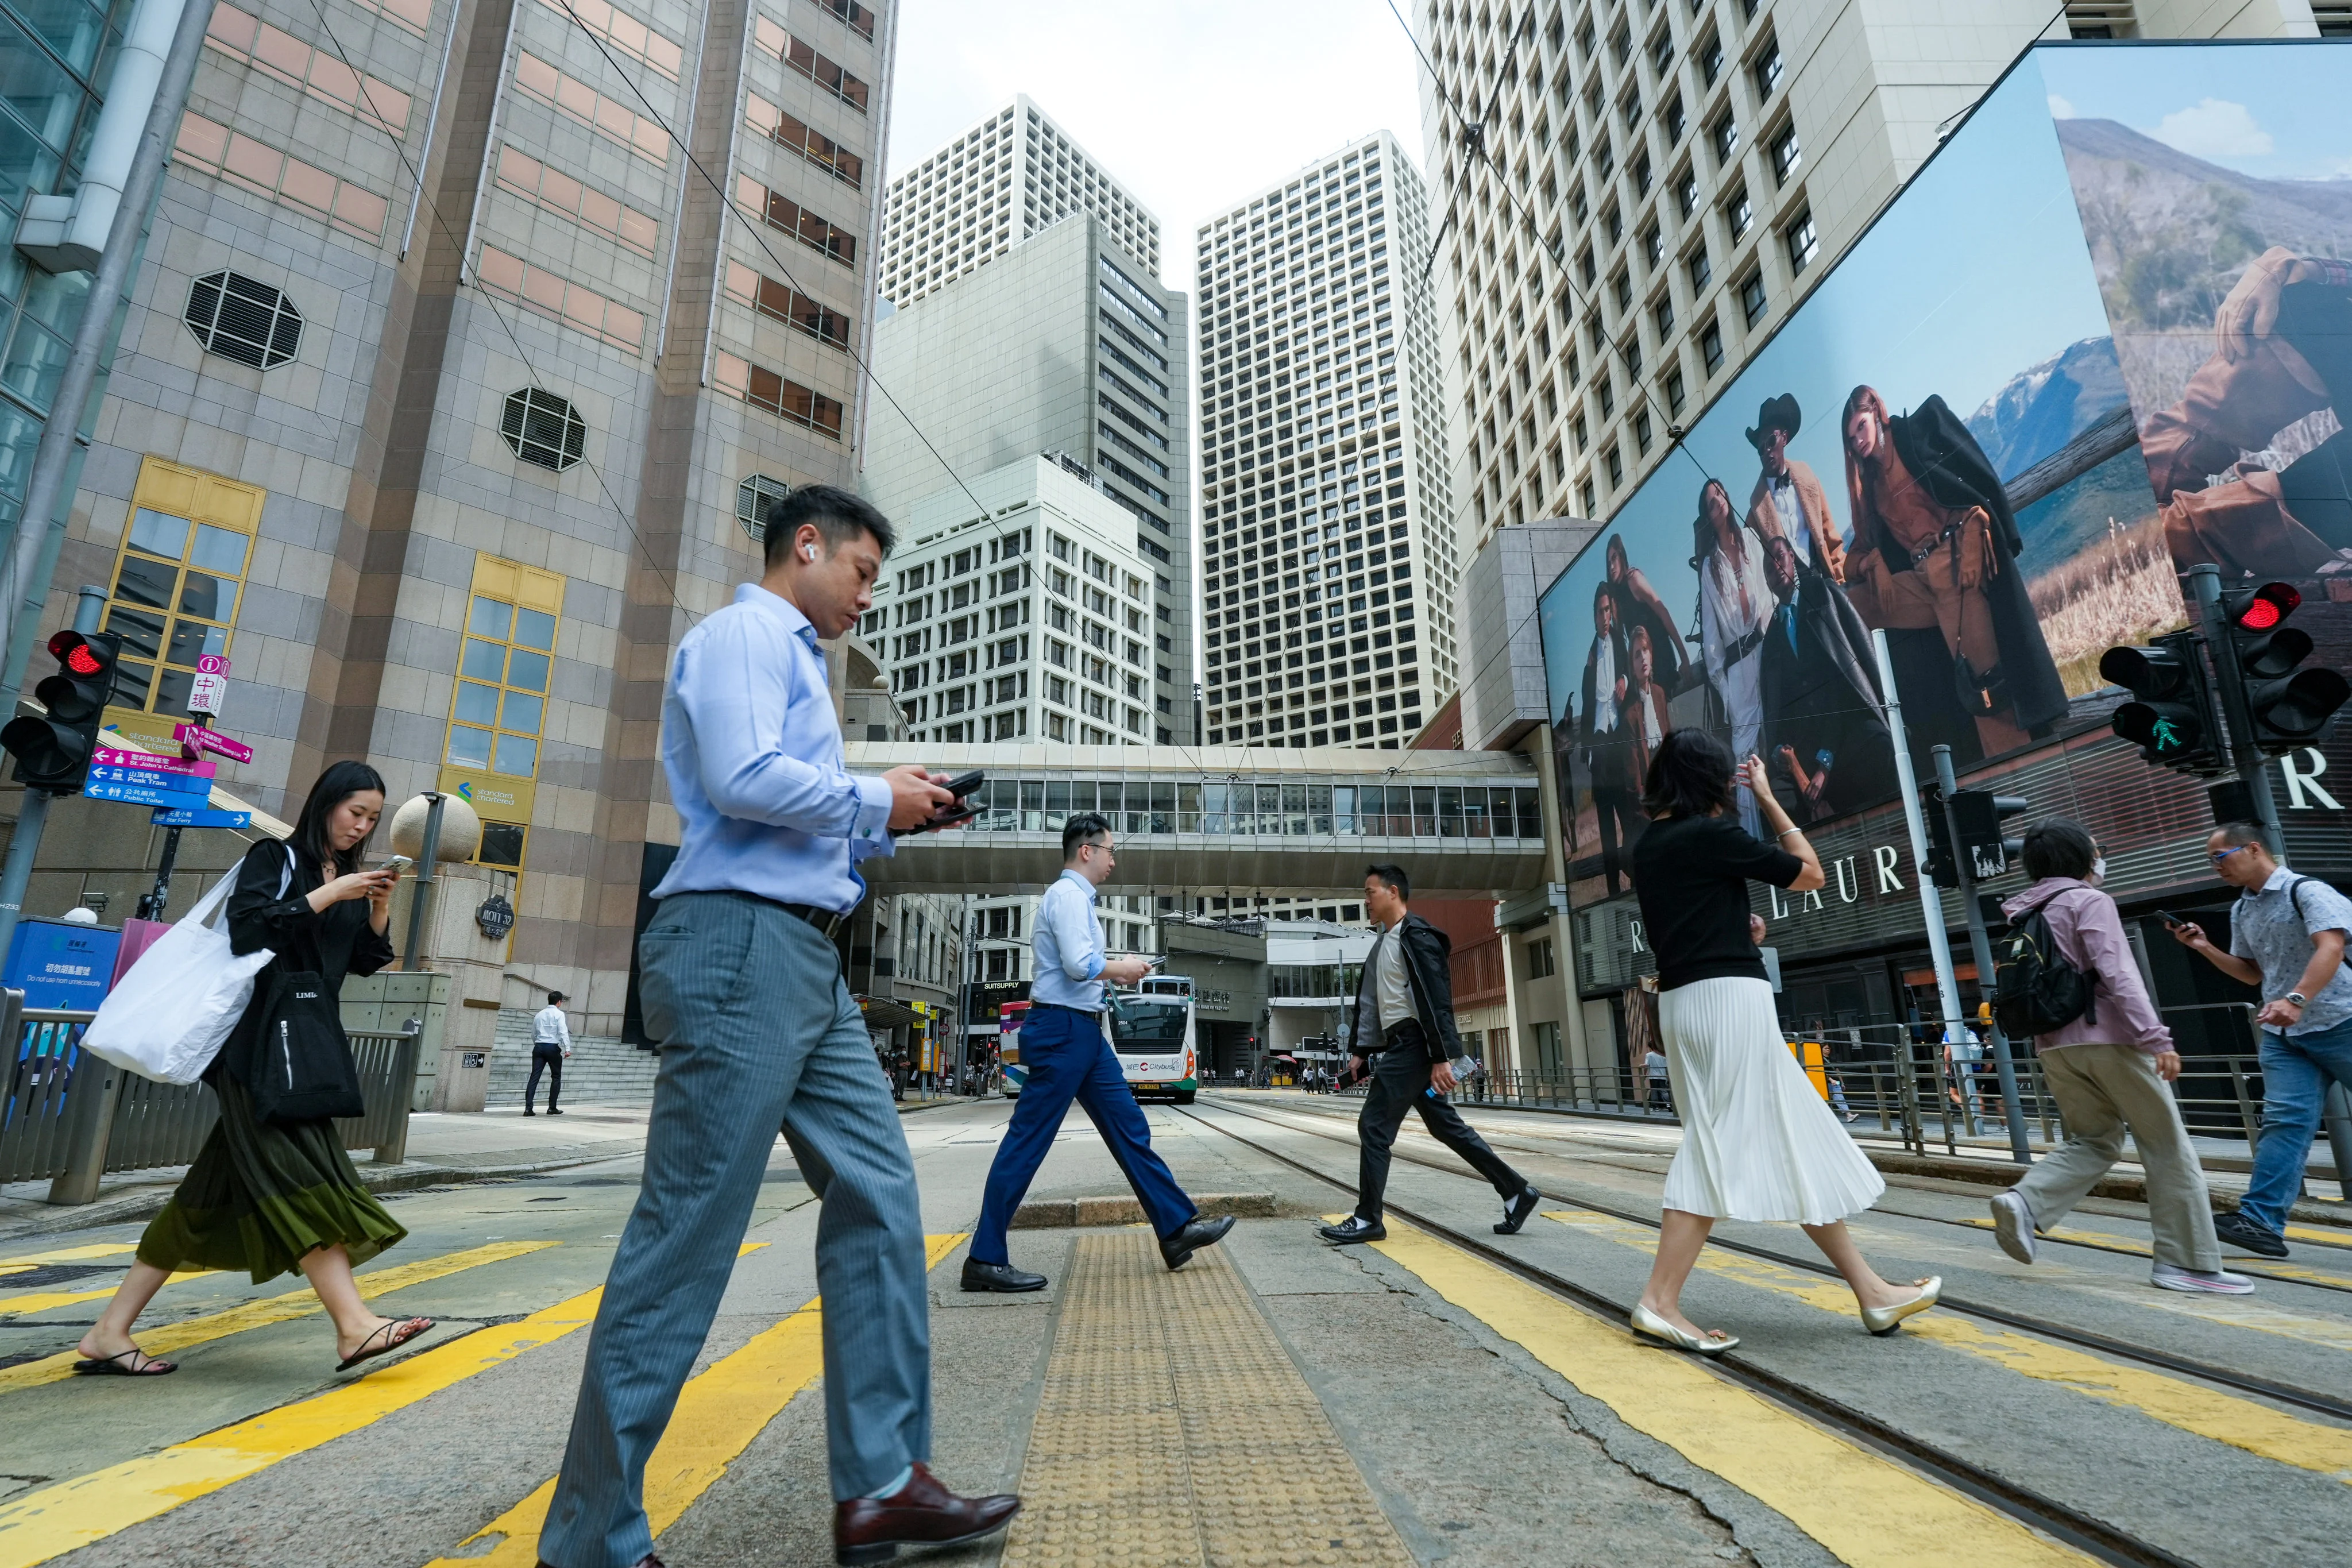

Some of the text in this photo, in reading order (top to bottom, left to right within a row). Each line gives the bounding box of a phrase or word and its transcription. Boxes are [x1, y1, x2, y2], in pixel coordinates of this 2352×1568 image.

[191, 677, 214, 708] 中環
[214, 680, 224, 712] Central
[204, 739, 219, 748] Weather
[219, 745, 234, 755] Shopping
[131, 754, 169, 764] 聖約翰座堂
[142, 762, 162, 770] John's
[164, 764, 194, 773] Cathedral
[128, 771, 160, 779] 山頂纜車
[125, 789, 156, 797] 公共廁所
[477, 788, 513, 799] standard
[476, 795, 514, 805] chartered
[482, 909, 512, 925] MOTT 32
[45, 963, 91, 976] 切勿胡亂響號
[68, 979, 102, 988] unnecessarily
